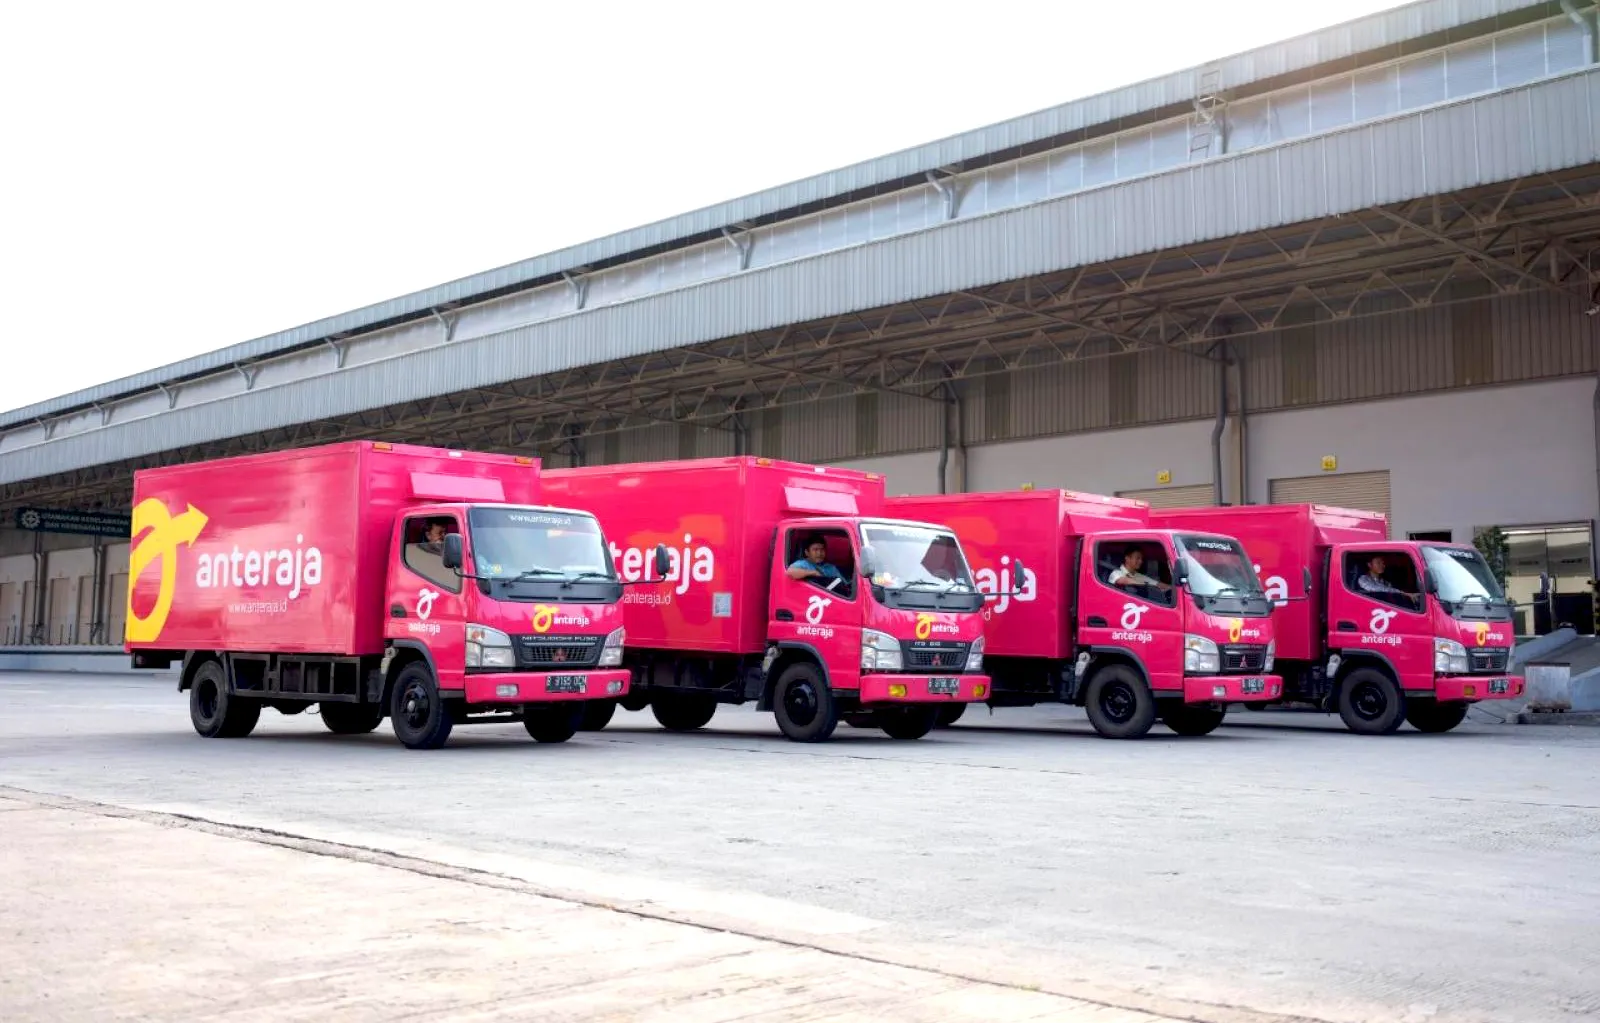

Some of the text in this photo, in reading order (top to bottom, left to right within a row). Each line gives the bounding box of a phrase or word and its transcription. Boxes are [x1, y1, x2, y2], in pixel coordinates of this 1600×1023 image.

[196, 533, 321, 599] anteraja
[228, 601, 287, 616] www.anteraja.id
[408, 621, 440, 636] anteraja
[553, 615, 590, 628] anteraja
[797, 625, 834, 639] anteraja
[1112, 630, 1152, 644] anteraja
[1361, 634, 1402, 647] anteraja
